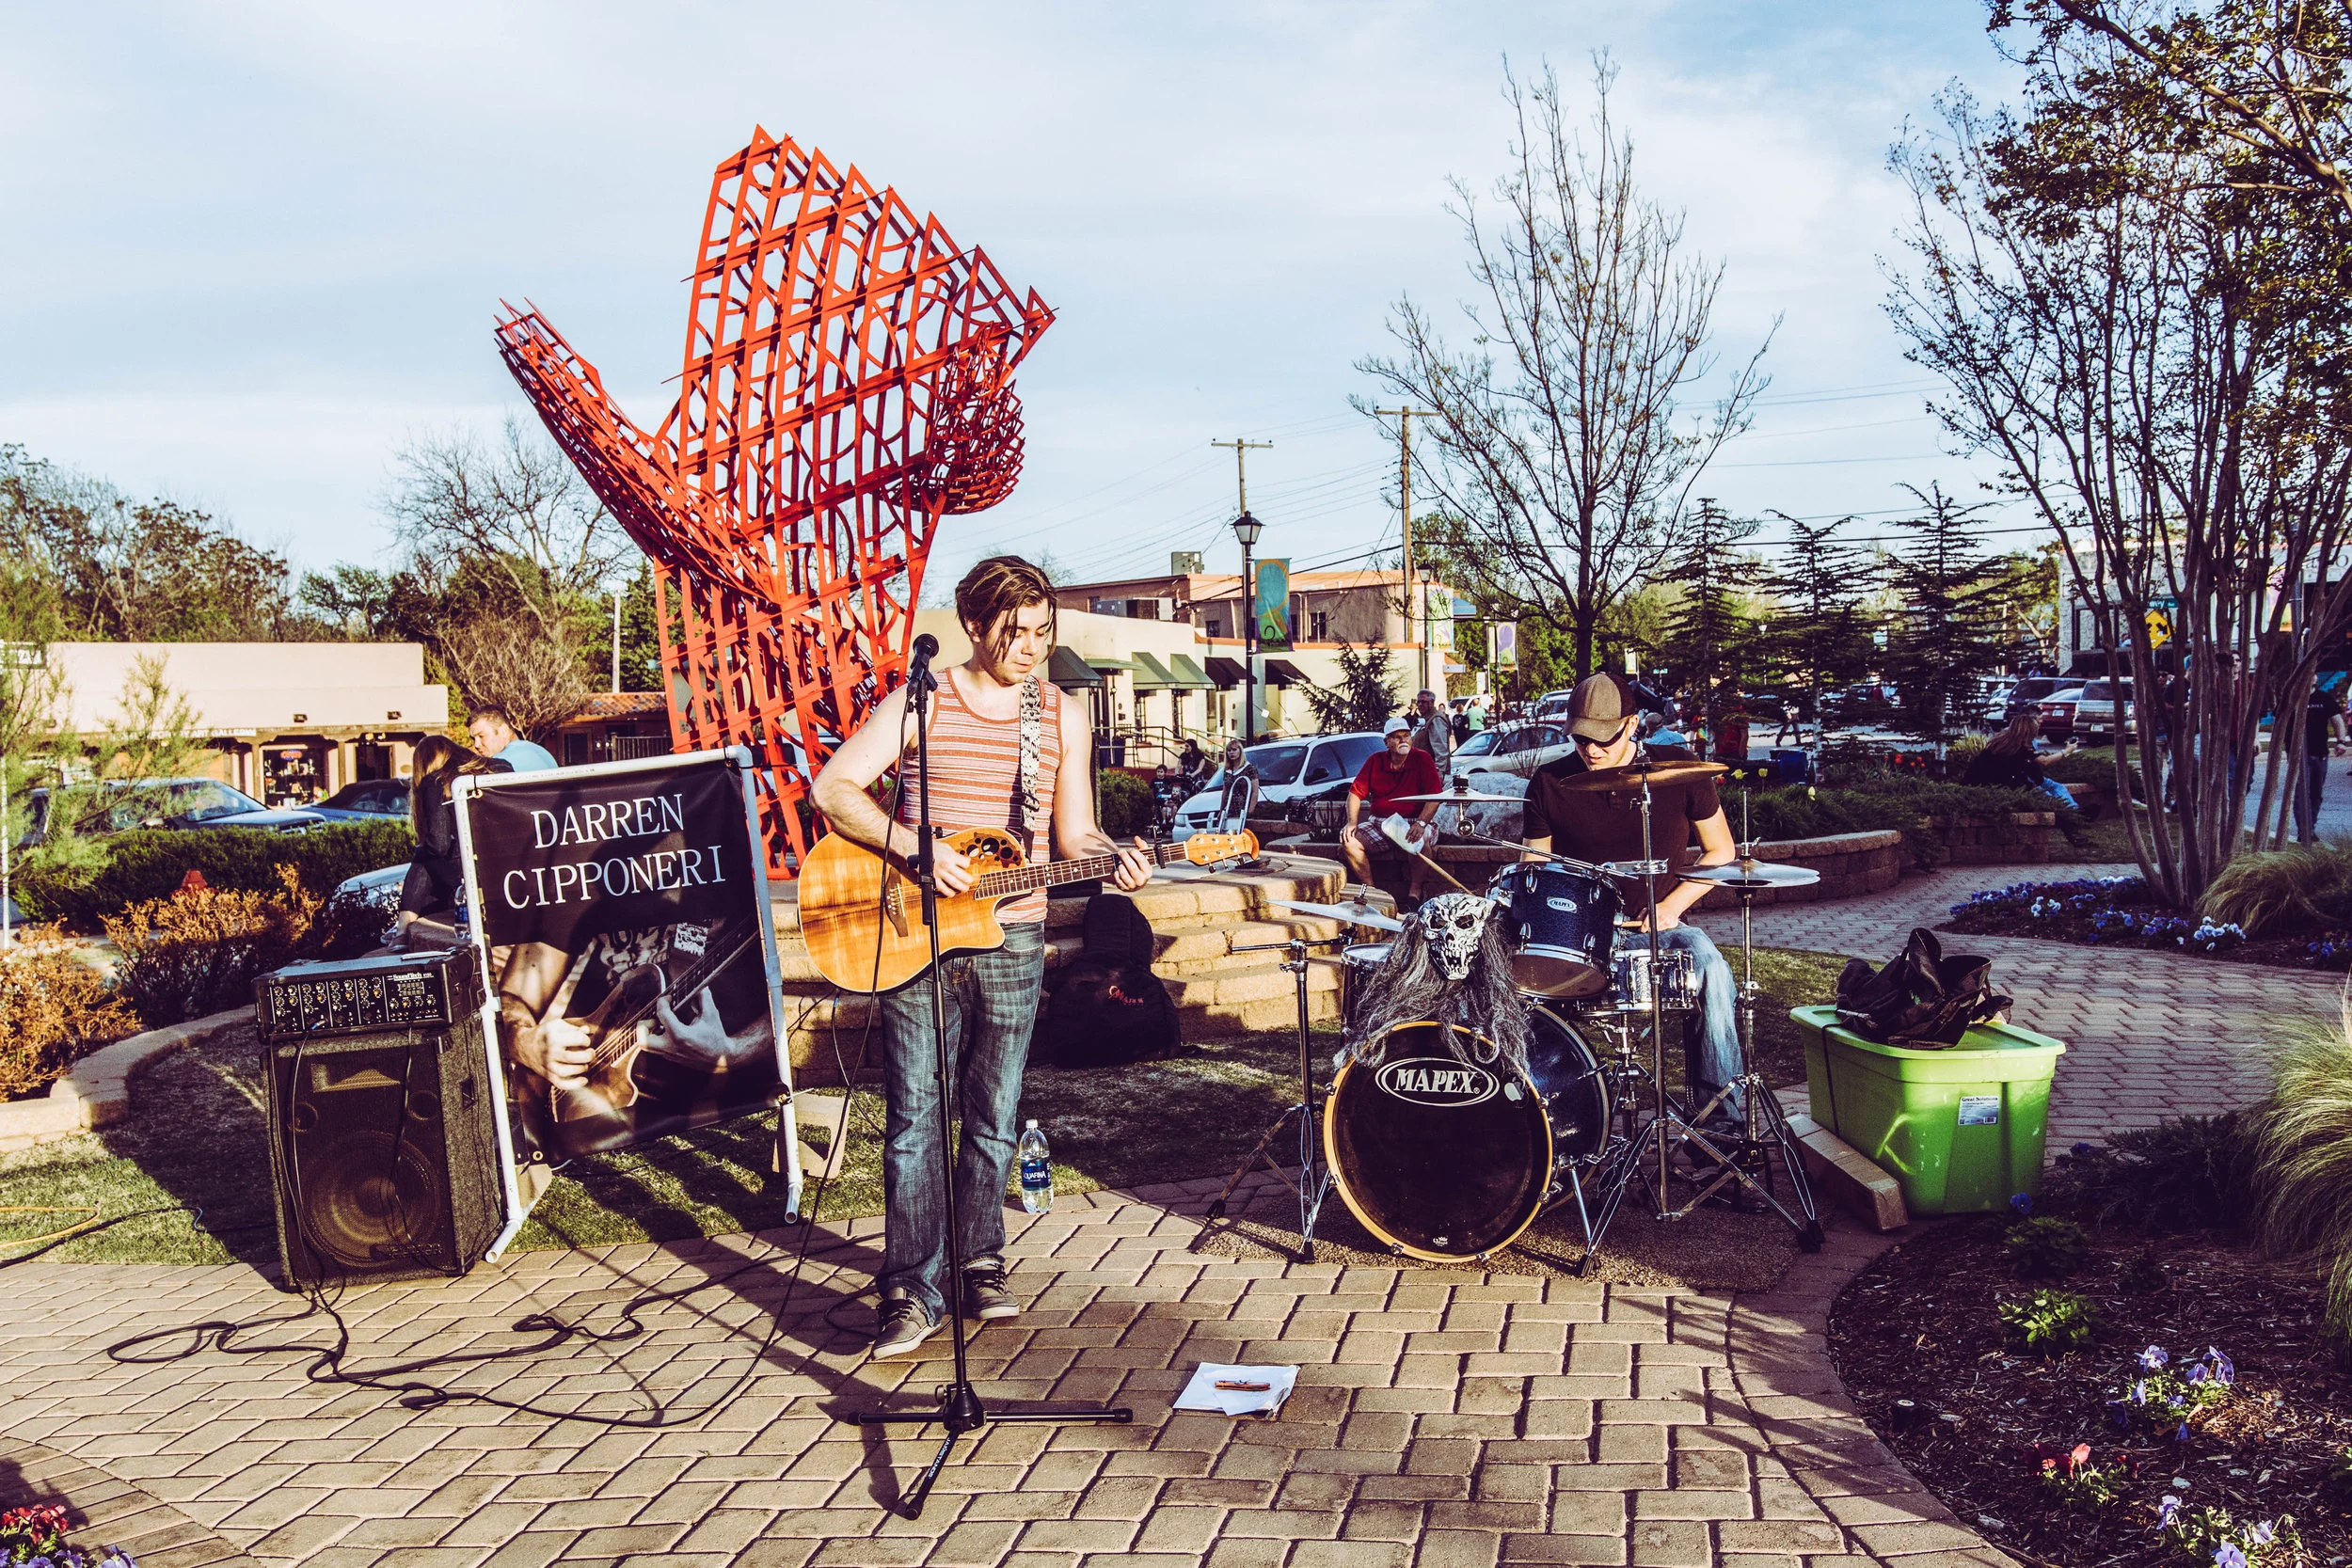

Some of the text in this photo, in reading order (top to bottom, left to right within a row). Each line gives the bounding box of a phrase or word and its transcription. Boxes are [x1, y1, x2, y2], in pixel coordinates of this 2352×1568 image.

[190, 729, 209, 737] ART
[531, 794, 684, 848] DARREN
[503, 846, 725, 910] CIPPONERI
[1393, 1069, 1477, 1093] MAPEX
[1023, 1171, 1046, 1180] QUAFINA
